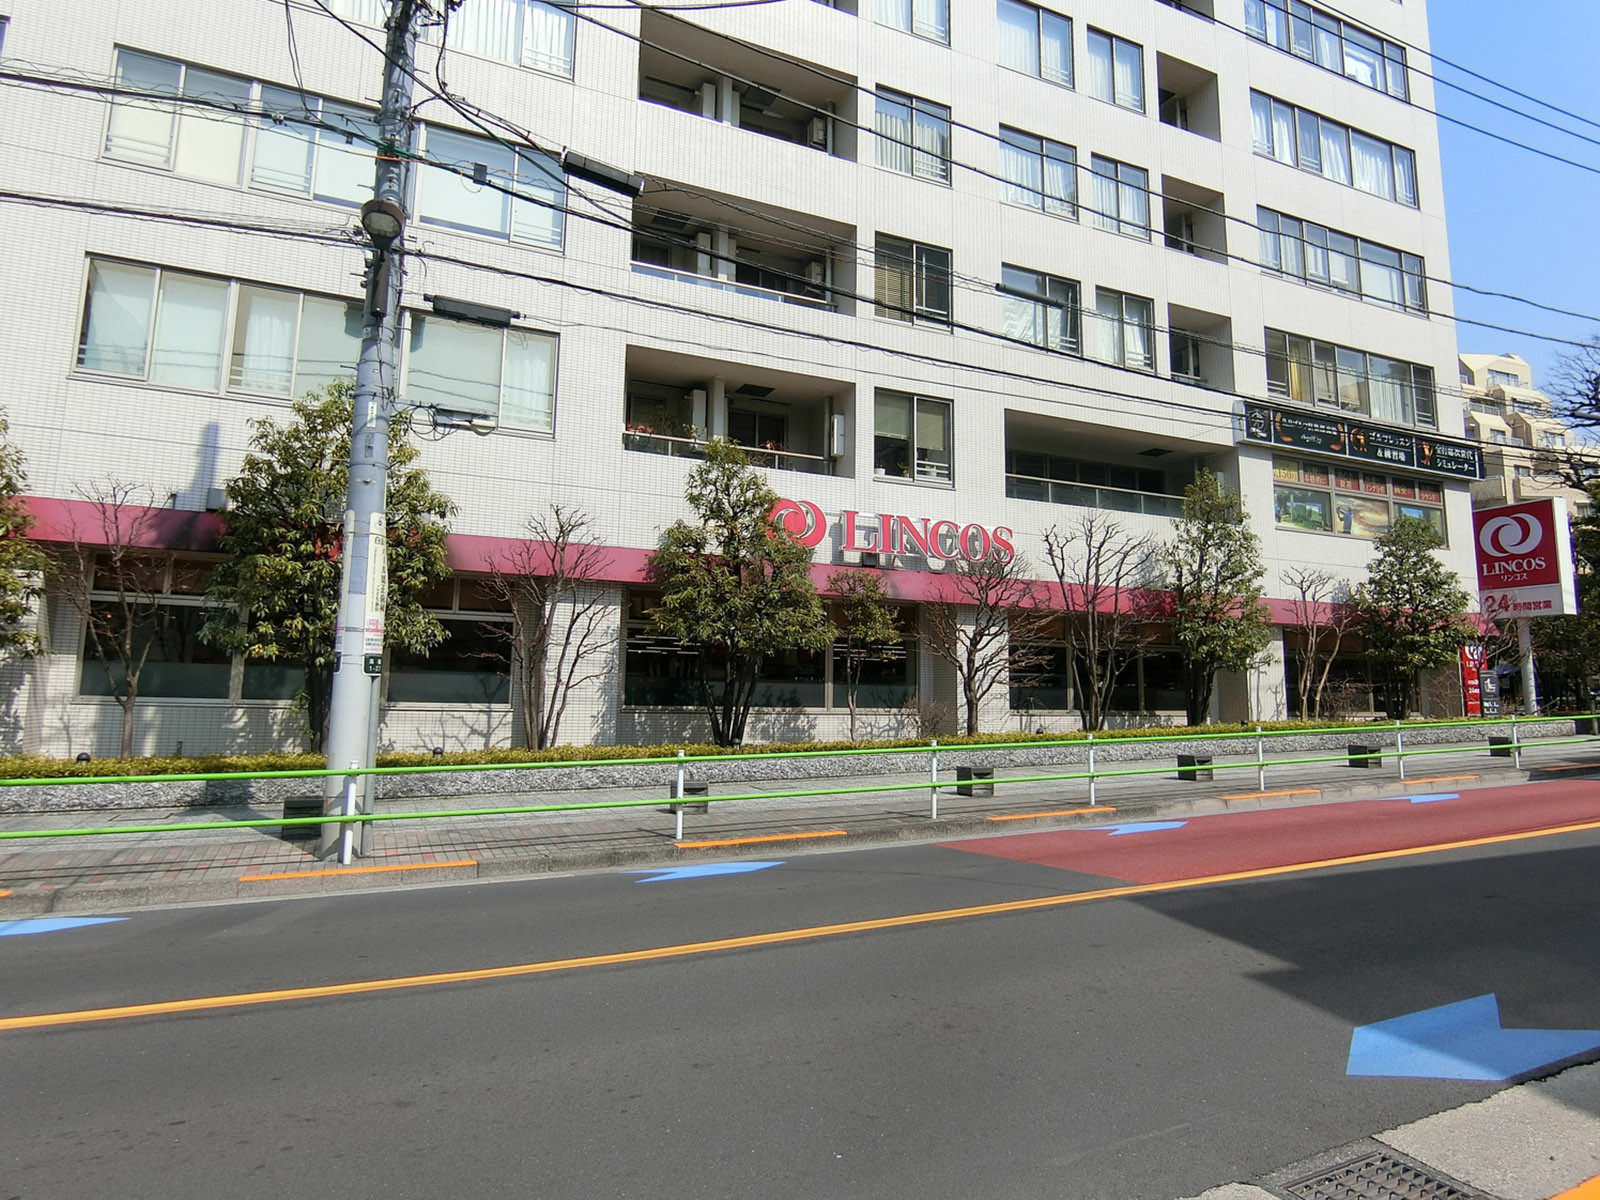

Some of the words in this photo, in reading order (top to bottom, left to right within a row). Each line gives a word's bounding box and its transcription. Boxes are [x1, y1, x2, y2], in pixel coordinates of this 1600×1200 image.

[1436, 458, 1476, 472] シミュレーター
[842, 509, 1016, 565] LINCOS
[1482, 556, 1547, 576] LINCOS
[1500, 572, 1529, 583] リンコス
